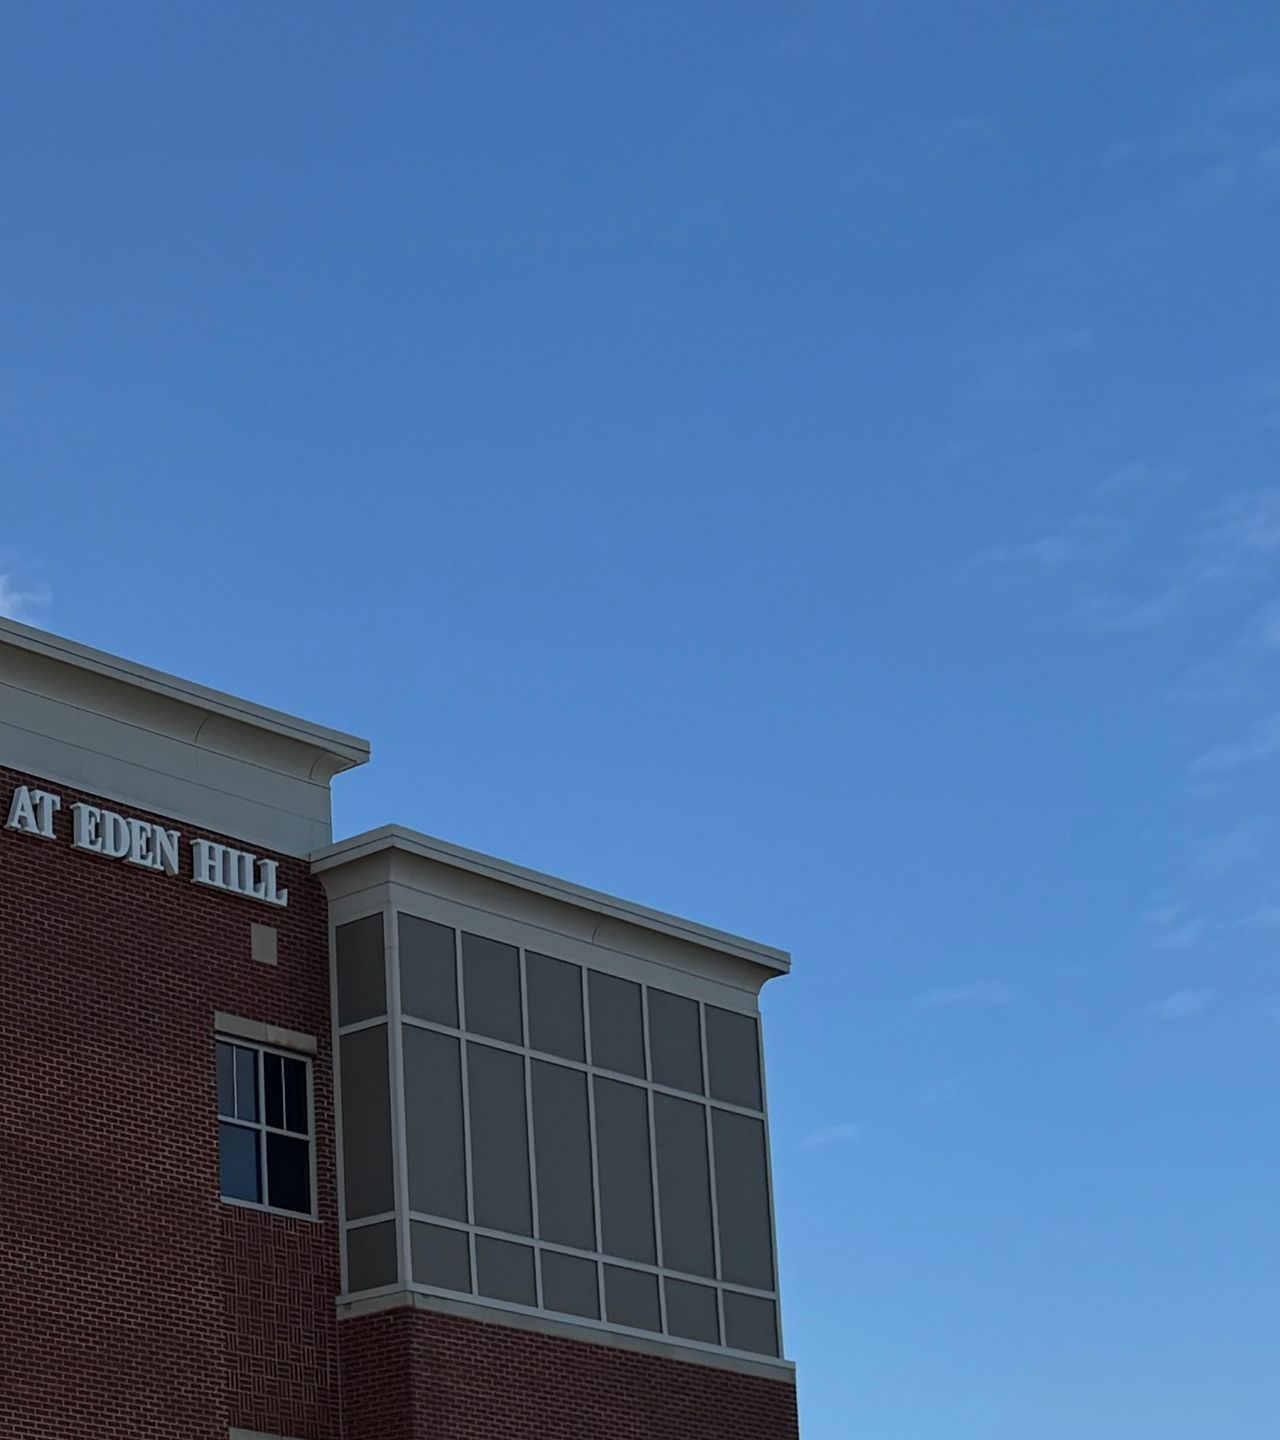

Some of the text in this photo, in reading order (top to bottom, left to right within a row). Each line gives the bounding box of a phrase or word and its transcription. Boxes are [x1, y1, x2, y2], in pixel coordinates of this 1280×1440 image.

[4, 785, 60, 839] AT
[70, 802, 181, 876] EDEN
[190, 838, 288, 907] HILL
